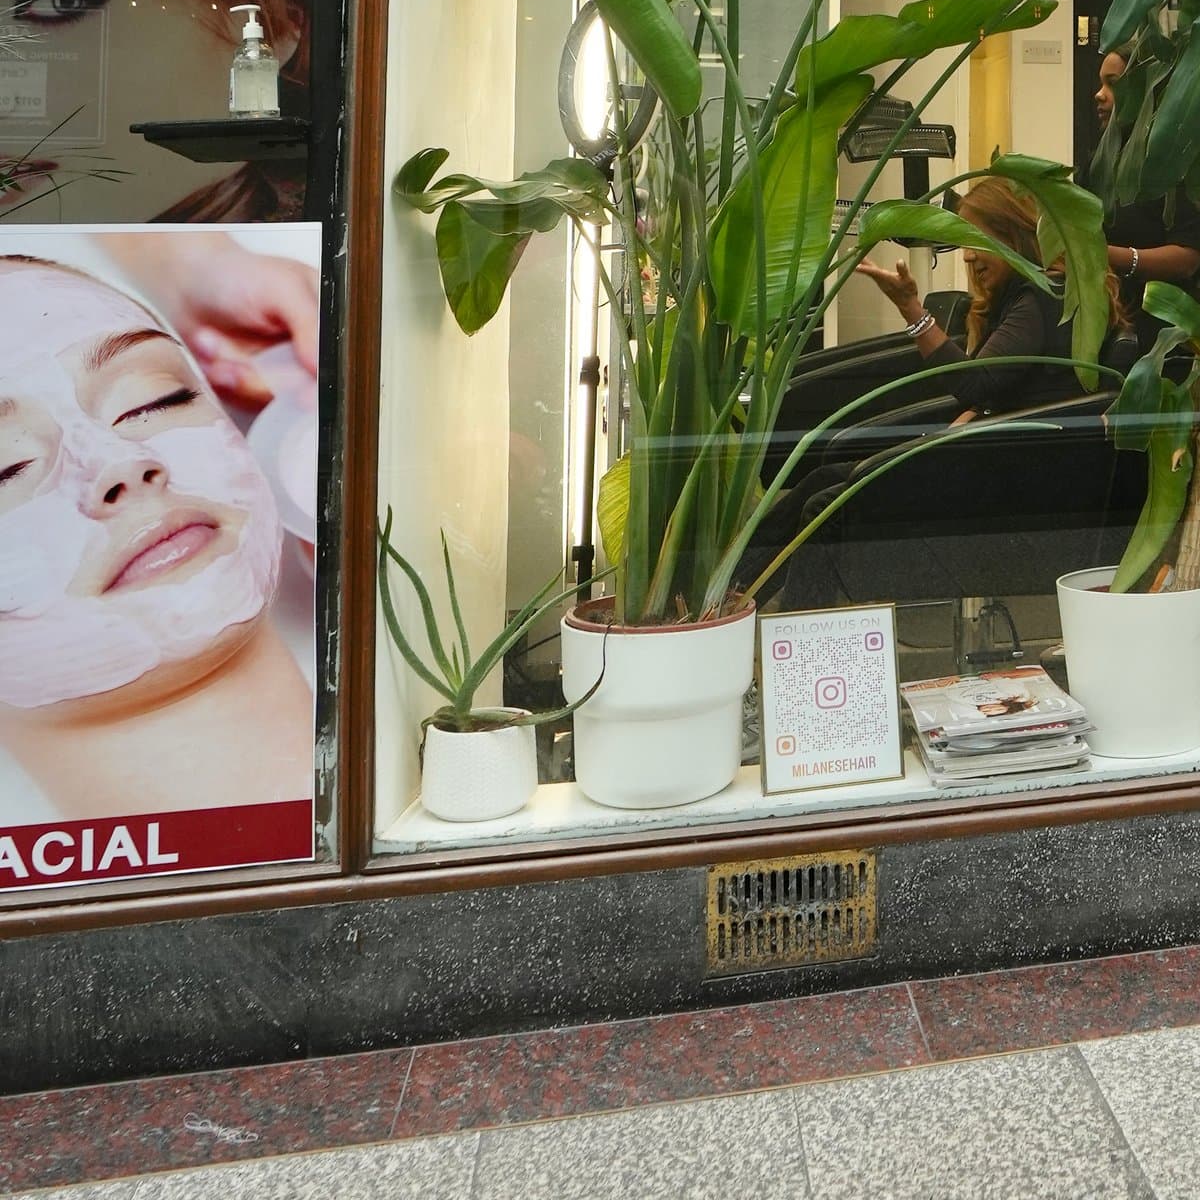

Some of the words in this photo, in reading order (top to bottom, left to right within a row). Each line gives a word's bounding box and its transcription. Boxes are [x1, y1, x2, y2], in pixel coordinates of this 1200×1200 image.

[774, 621, 833, 637] FOLLOW
[839, 619, 856, 630] US
[860, 617, 880, 628] ON
[792, 755, 876, 778] MILANESEHAIR
